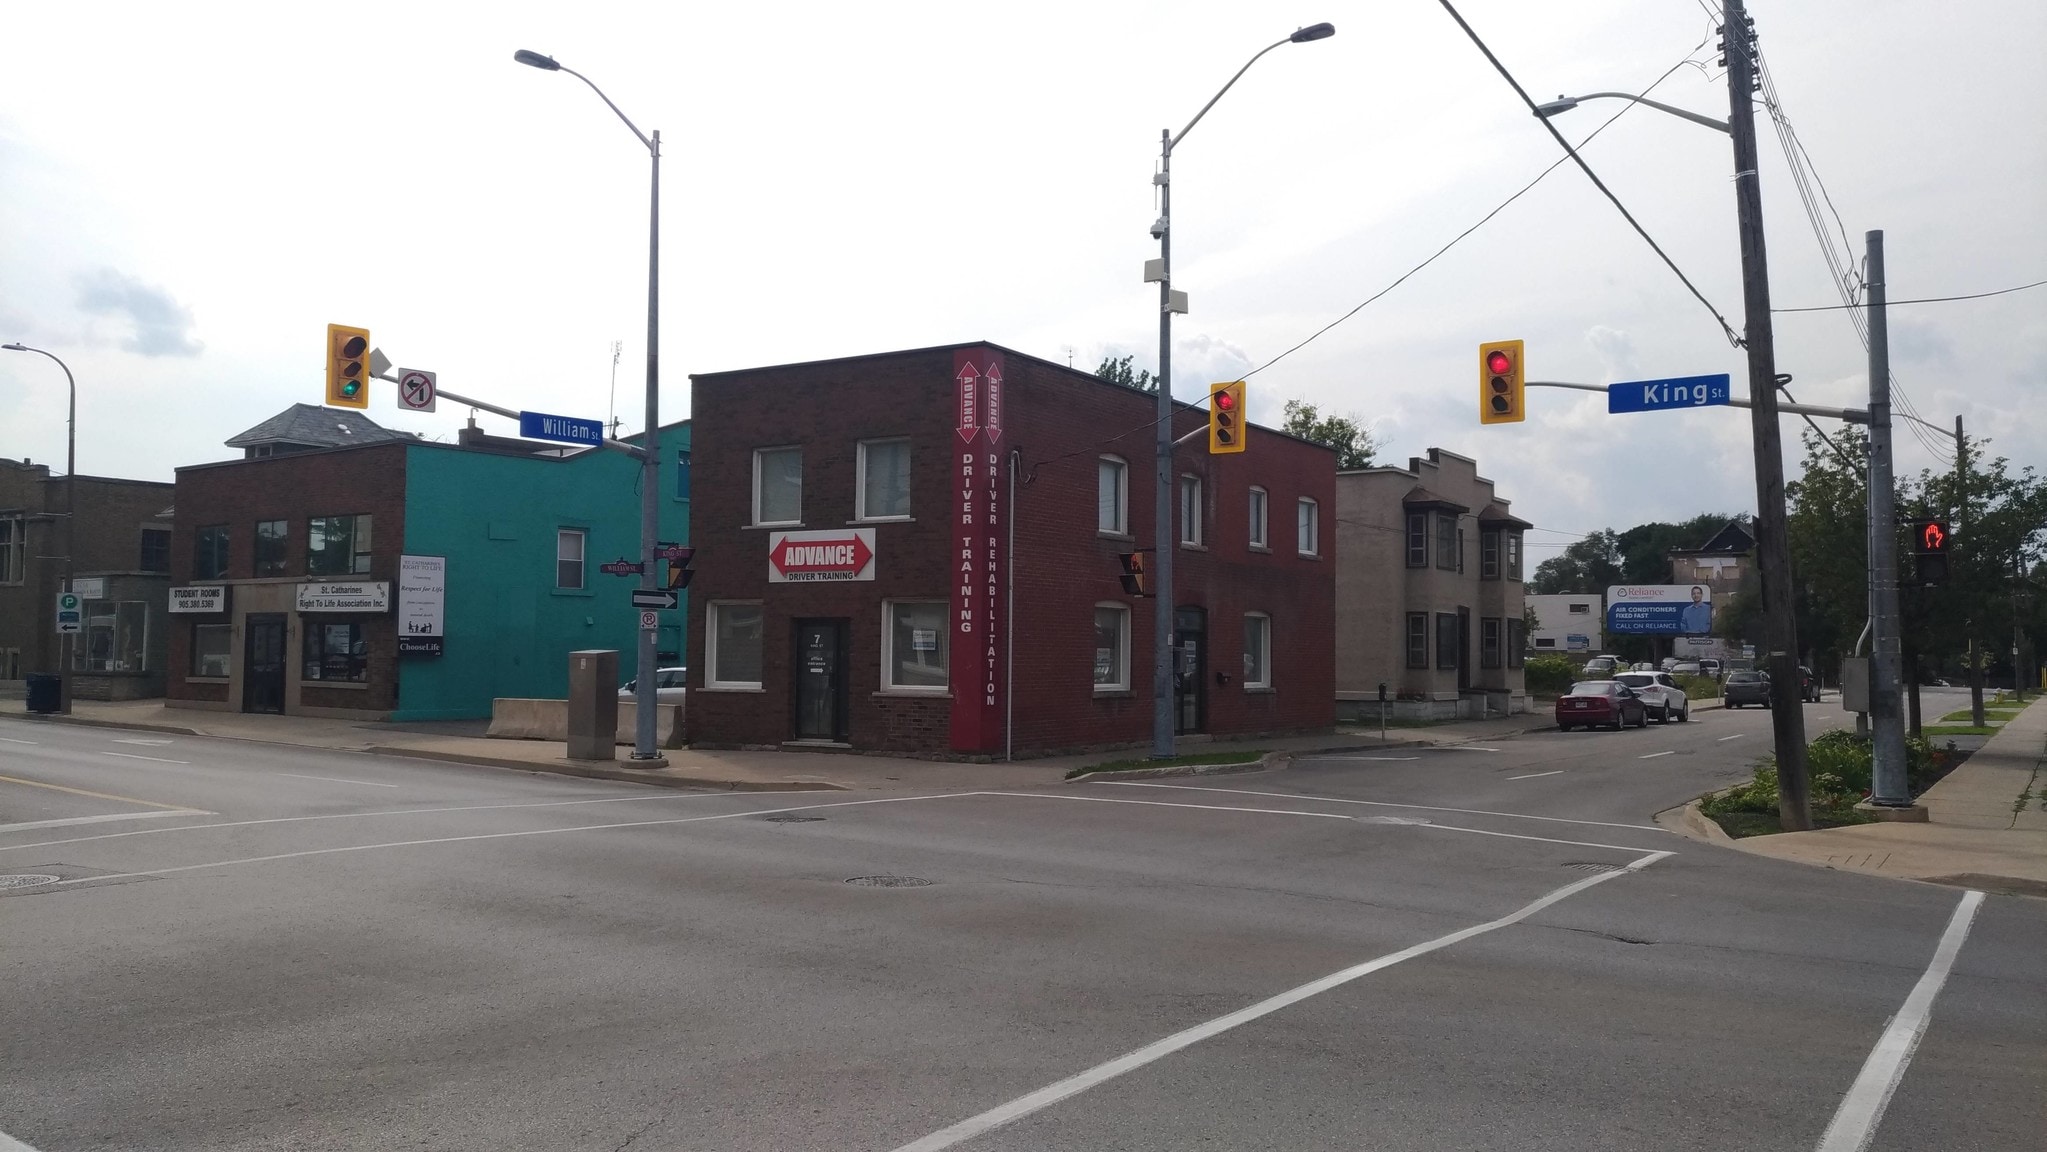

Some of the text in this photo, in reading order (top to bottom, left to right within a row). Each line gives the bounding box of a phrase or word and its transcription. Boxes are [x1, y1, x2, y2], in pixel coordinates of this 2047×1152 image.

[1643, 383, 1725, 404] King St.
[963, 376, 973, 430] ADVANCE
[990, 376, 998, 430] ADVANCE
[543, 417, 589, 439] William
[961, 453, 973, 633] DRIVER TRAINING
[784, 545, 854, 566] ADVANCE
[817, 572, 853, 580] TRAINING
[987, 454, 997, 706] DRIVER REHABILITATION
[174, 589, 220, 598] STUDENT ROOMS
[321, 586, 362, 594] St. Catharines
[1628, 588, 1664, 596] Reliance
[66, 597, 73, 606] P
[299, 599, 385, 609] Right To Life Association Inc.
[814, 634, 820, 644] 7
[399, 643, 440, 651] ChooseLife
